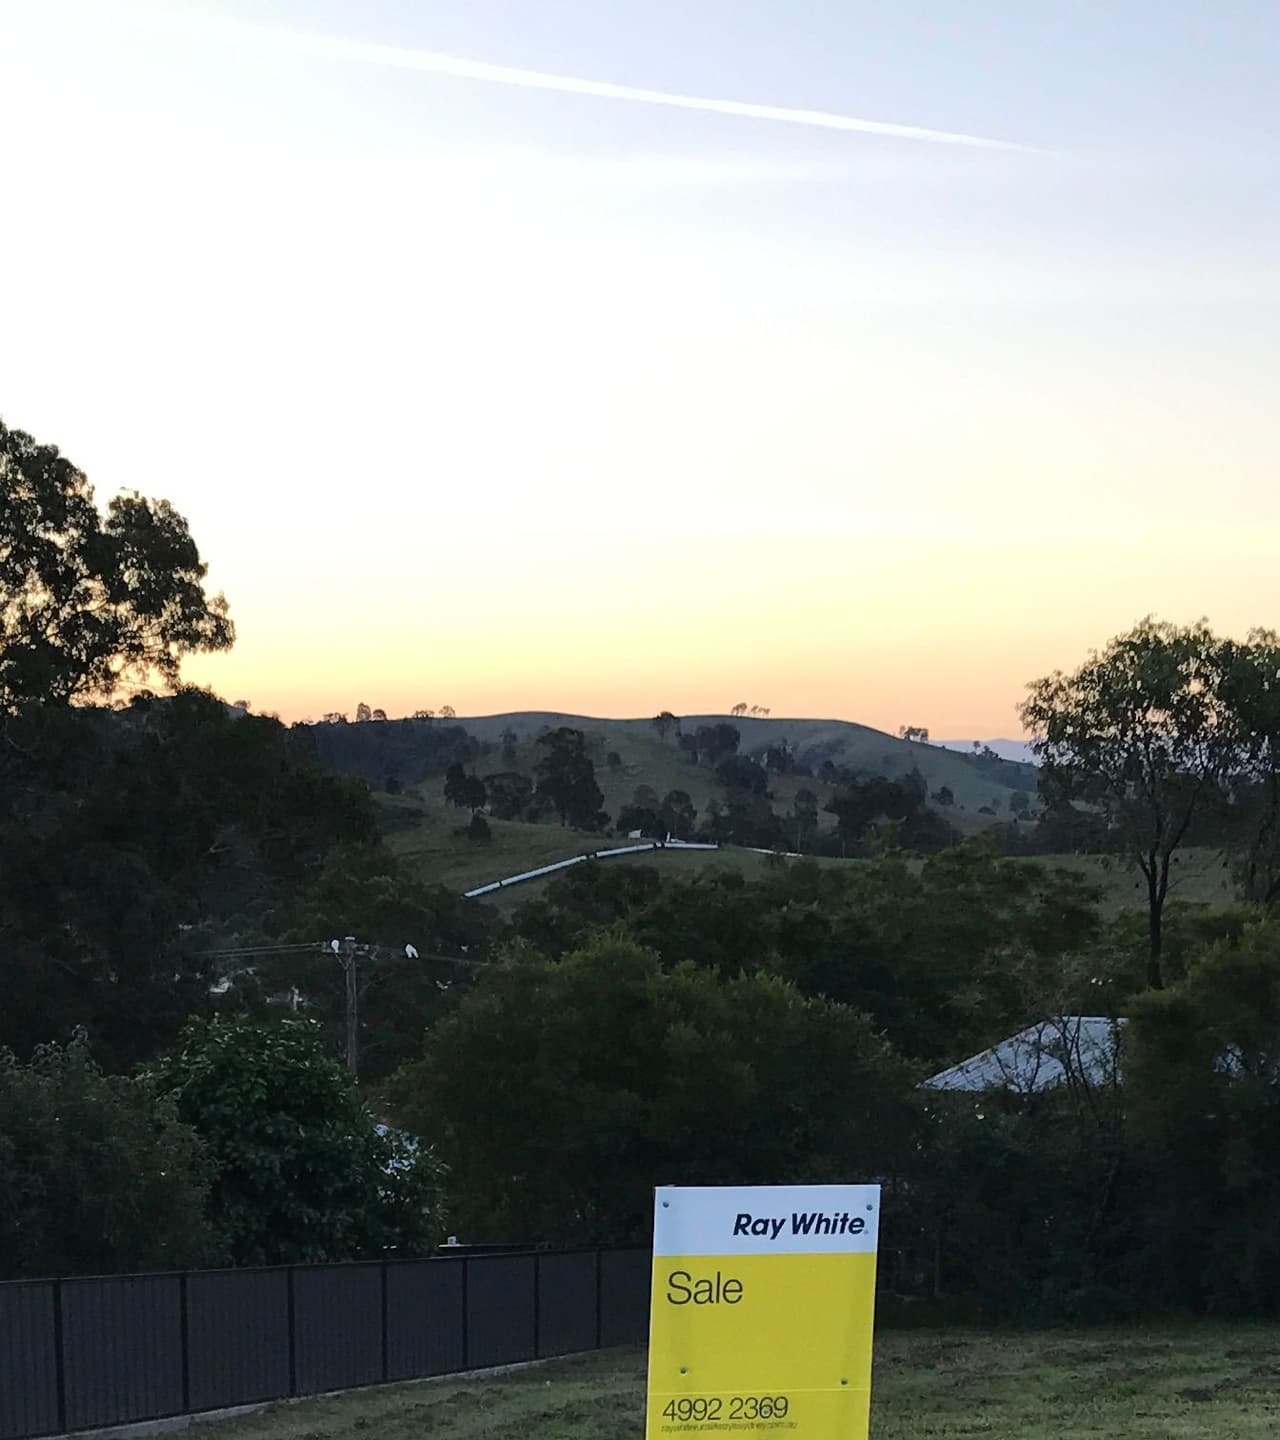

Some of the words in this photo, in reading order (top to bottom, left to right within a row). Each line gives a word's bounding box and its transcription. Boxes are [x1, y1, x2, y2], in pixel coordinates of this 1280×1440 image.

[733, 1213, 785, 1240] Ray
[791, 1212, 865, 1235] White
[667, 1271, 743, 1304] Sale
[662, 1398, 722, 1421] 4992
[729, 1396, 789, 1420] 2369
